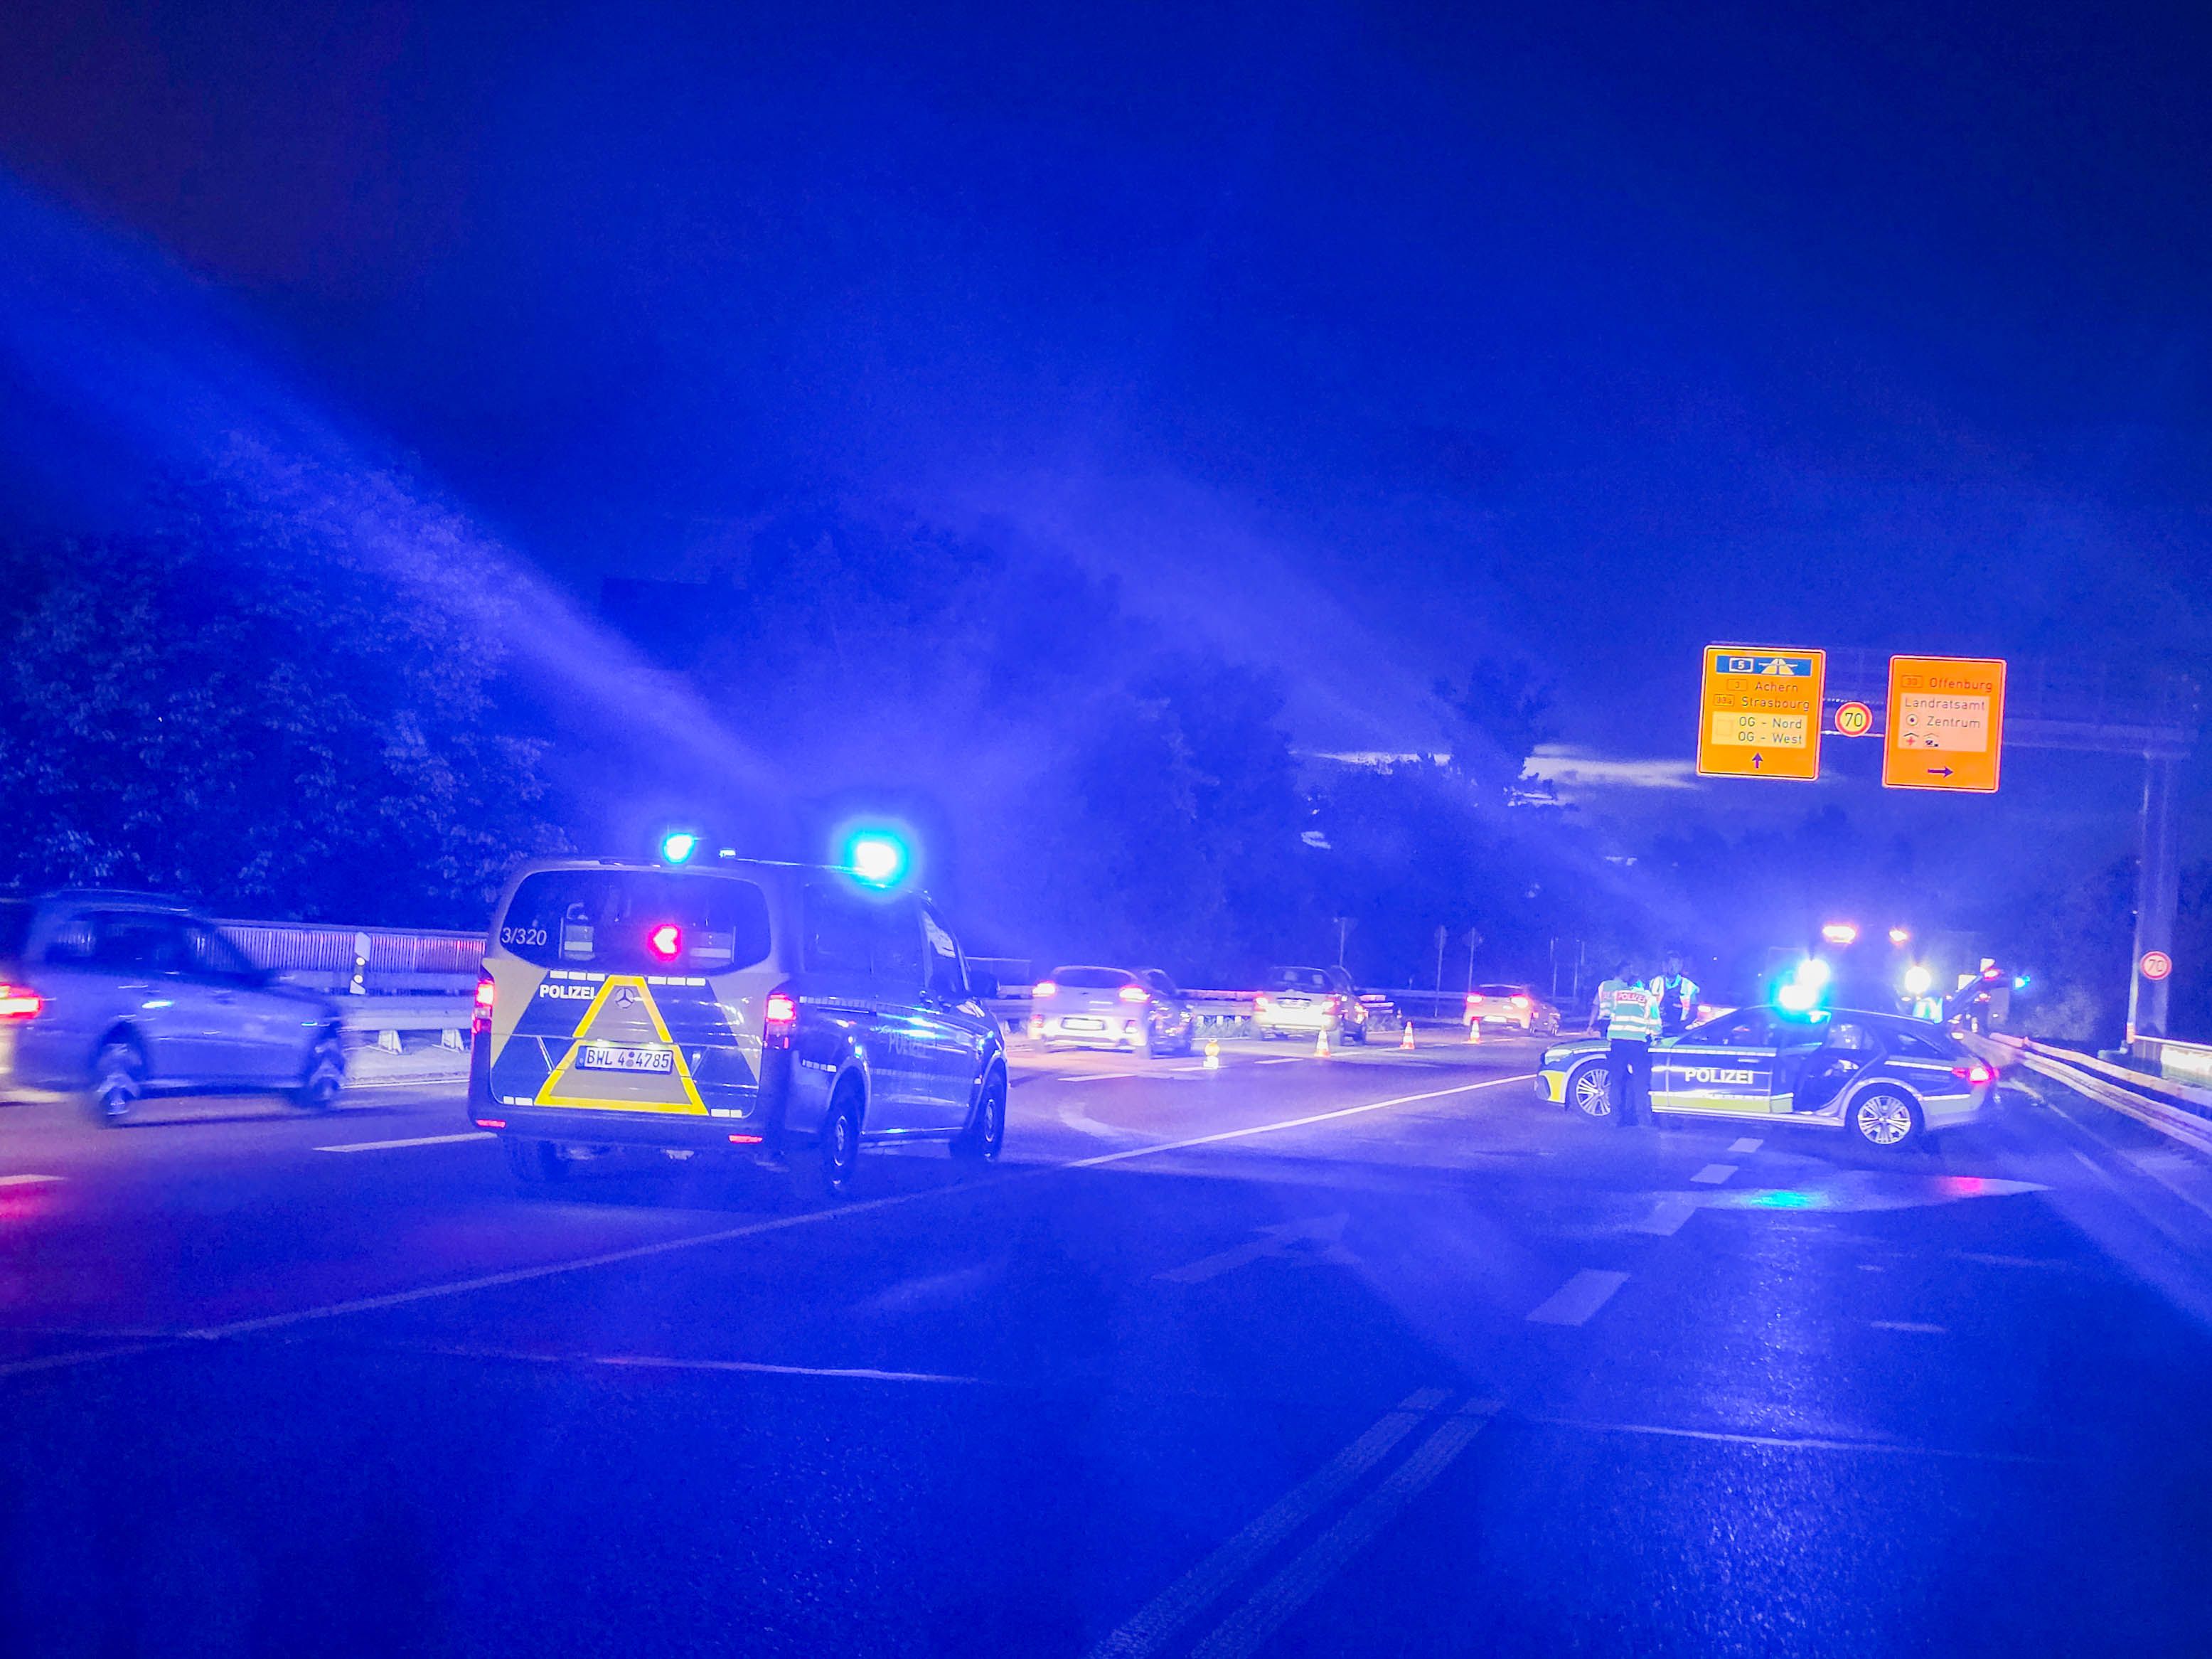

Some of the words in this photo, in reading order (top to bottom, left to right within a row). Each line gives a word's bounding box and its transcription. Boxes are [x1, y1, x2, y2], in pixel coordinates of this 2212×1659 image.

[1737, 660, 1746, 670] 5
[1734, 681, 1741, 689] 3
[1754, 681, 1799, 692] Achern
[1929, 677, 1993, 693] Offenburg
[1741, 695, 1810, 711] Strasbourg
[1904, 697, 1985, 710] Landratsamt
[1738, 715, 1756, 727] OG
[1772, 717, 1802, 729] Nord
[1844, 712, 1864, 727] 70
[1926, 715, 1981, 728] Zentrum
[1737, 731, 1755, 742] OG
[1771, 732, 1802, 745] West
[501, 927, 547, 946] 3/320
[539, 984, 595, 1000] POLIZEI
[586, 1049, 613, 1065] BWL
[635, 1052, 670, 1068] 4785
[1684, 1069, 1754, 1084] POLIZEI
